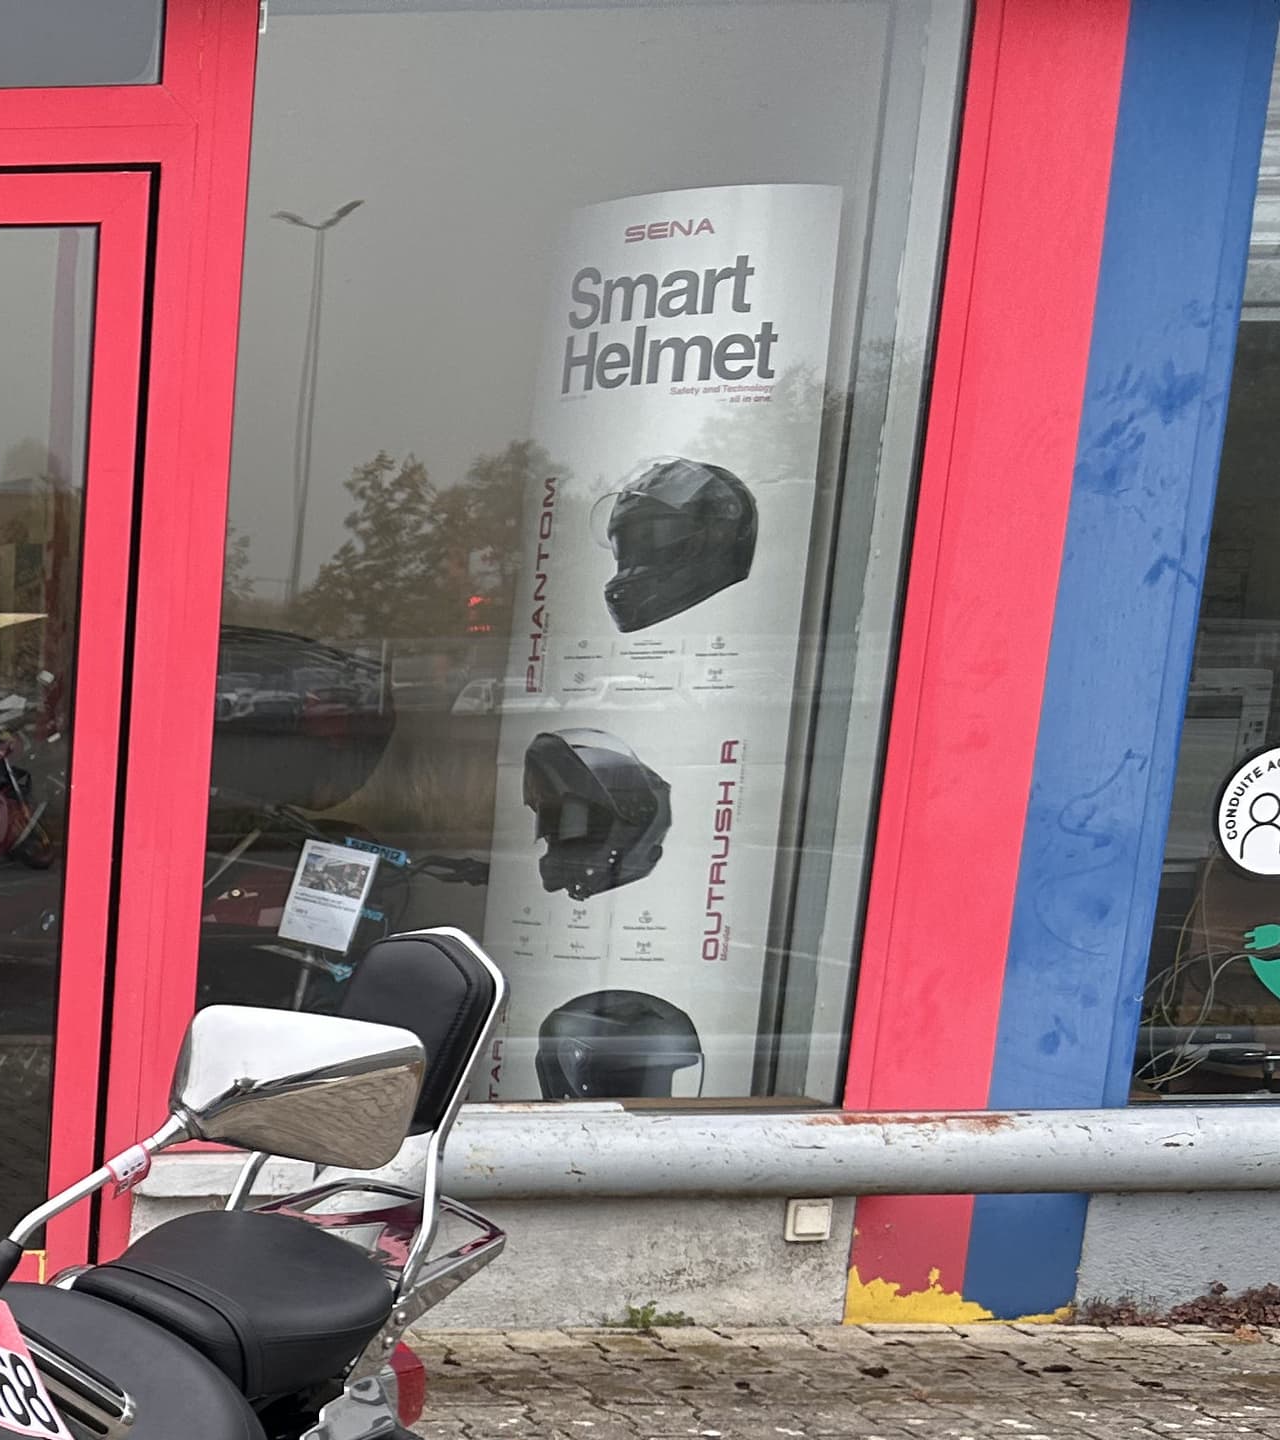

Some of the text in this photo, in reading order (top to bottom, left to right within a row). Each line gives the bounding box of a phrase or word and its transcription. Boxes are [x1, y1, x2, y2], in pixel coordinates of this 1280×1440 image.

[624, 218, 716, 244] SENA
[568, 254, 755, 329] Smart
[561, 322, 778, 394] Helmet
[526, 477, 557, 693] PHANTOM
[1225, 766, 1265, 840] CONDUITE
[702, 781, 736, 961] OUTRUSH
